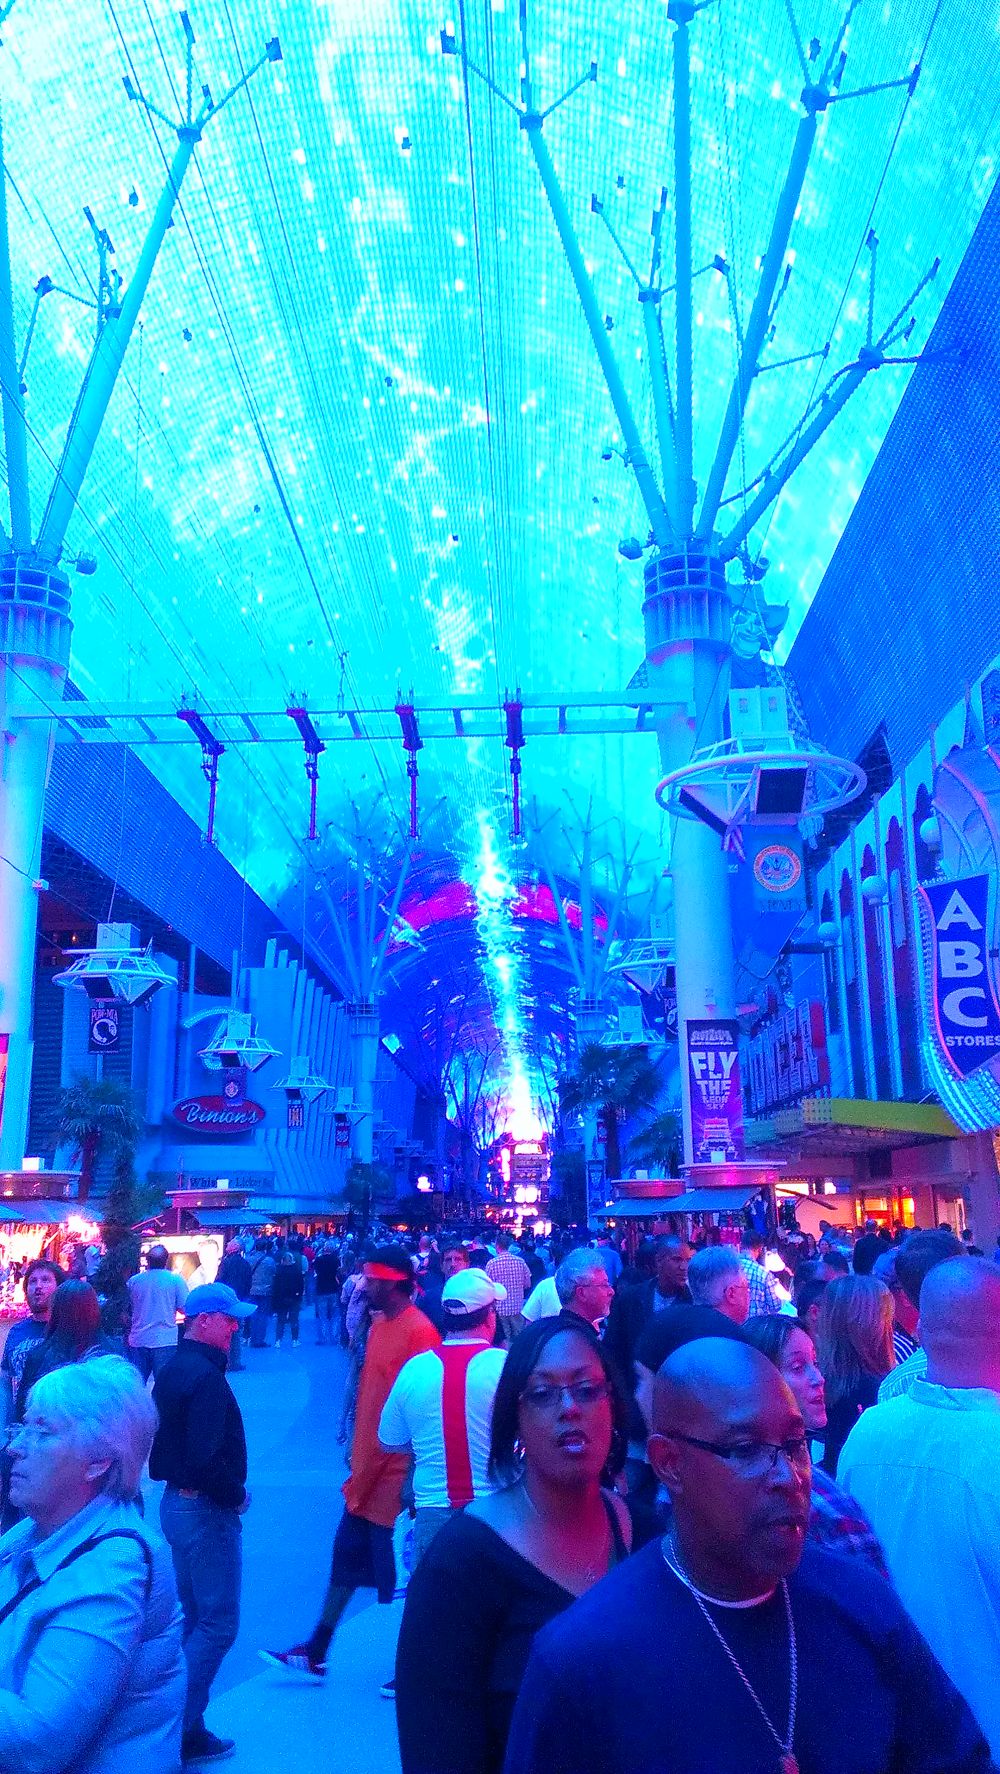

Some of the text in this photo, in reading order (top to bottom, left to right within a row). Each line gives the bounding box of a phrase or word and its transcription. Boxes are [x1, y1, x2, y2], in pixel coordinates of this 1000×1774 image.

[936, 888, 988, 1028] ABC
[945, 1035, 1000, 1047] STORES
[690, 1051, 739, 1079] FLY
[697, 1080, 732, 1096] THE
[181, 1103, 259, 1124] Binion's
